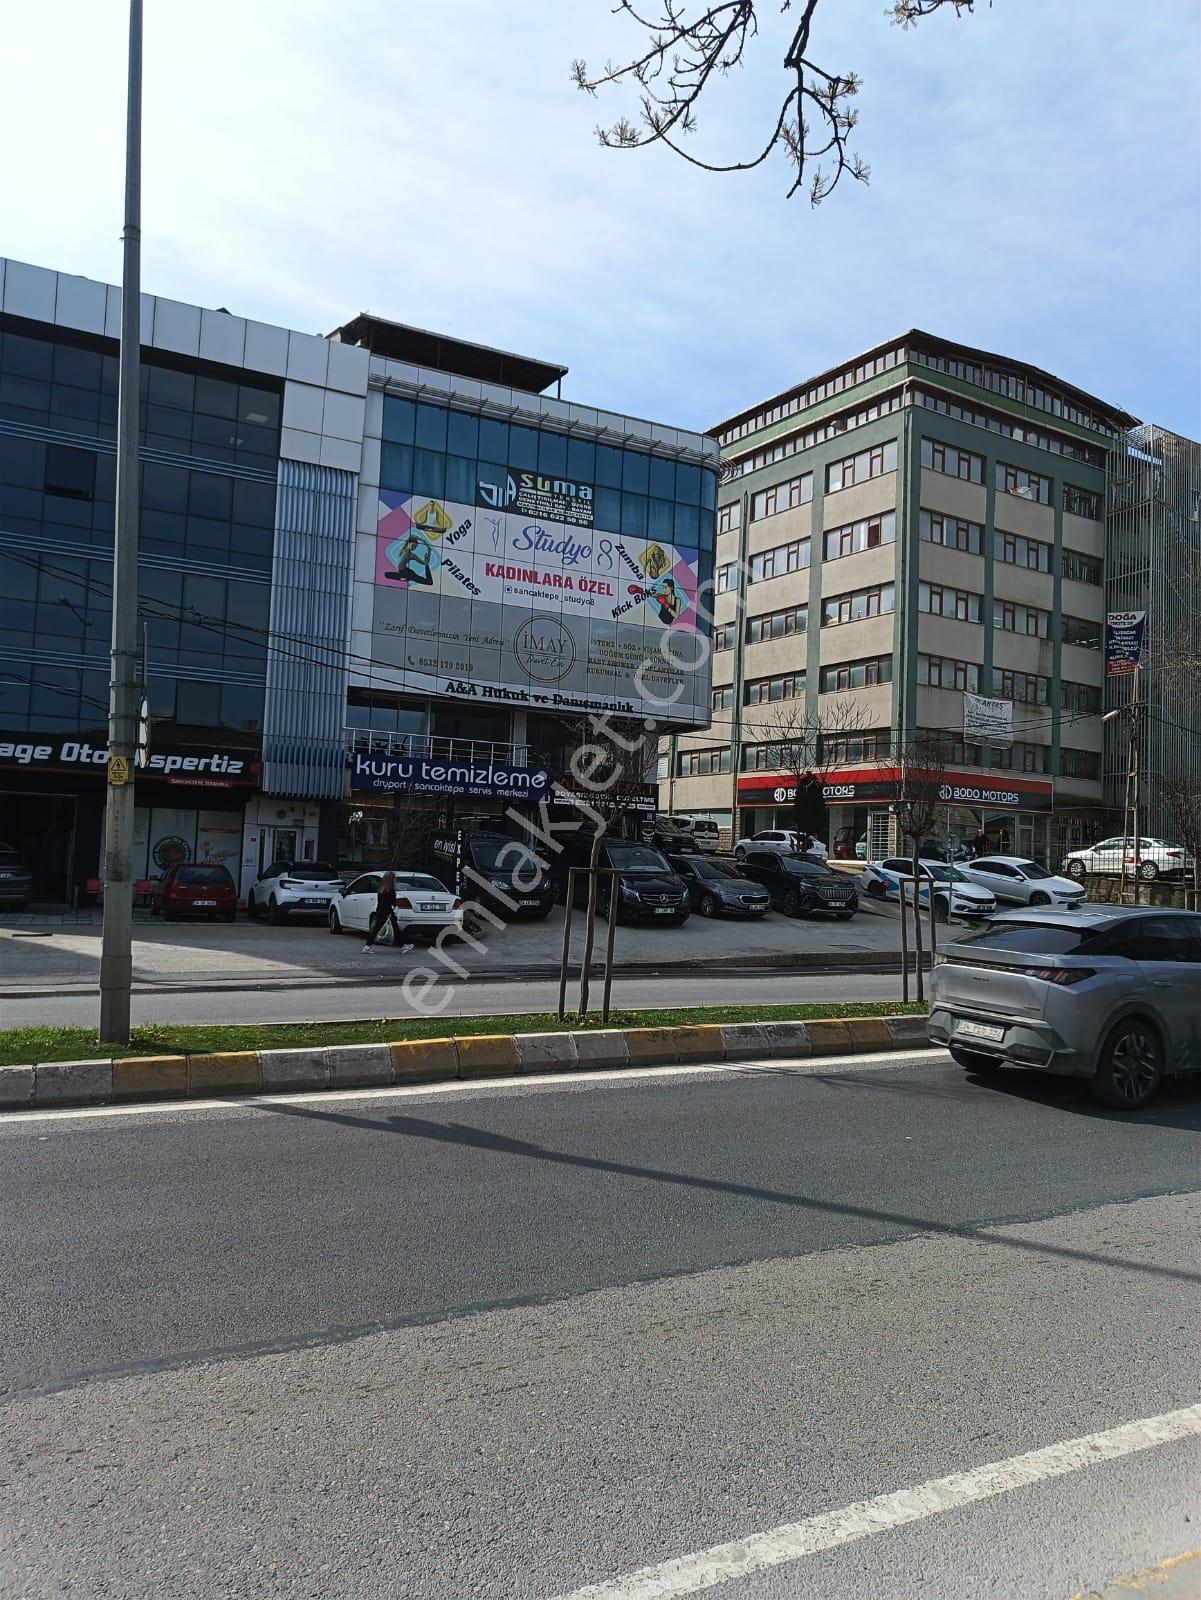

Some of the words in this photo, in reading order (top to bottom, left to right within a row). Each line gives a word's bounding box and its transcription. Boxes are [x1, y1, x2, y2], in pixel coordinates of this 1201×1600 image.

[446, 519, 472, 545] Yoga
[597, 539, 613, 571] 8
[615, 543, 644, 580] Zumba
[441, 558, 481, 596] Pilates
[485, 562, 574, 590] KADINLARA
[578, 576, 614, 597] ÖZEL
[612, 599, 633, 618] Kick
[634, 586, 657, 605] Boks
[1109, 612, 1137, 621] DOĞA
[523, 630, 567, 653] İMAY
[418, 658, 438, 667] 0532
[445, 681, 478, 696] A&A
[482, 685, 530, 702] Hukuk
[530, 694, 549, 705] ve
[552, 693, 634, 713] Danışmanlık
[60, 742, 110, 763] Oto
[134, 748, 244, 774] spertiz
[356, 754, 413, 778] kuru
[421, 762, 546, 788] temizleme
[373, 779, 407, 790] dryport
[414, 782, 465, 795] sancaktepe
[468, 786, 493, 796] servis
[496, 789, 529, 798] merkezi
[823, 785, 855, 796] OTORS
[953, 787, 980, 799] BODO
[982, 788, 1019, 802] MOTORS
